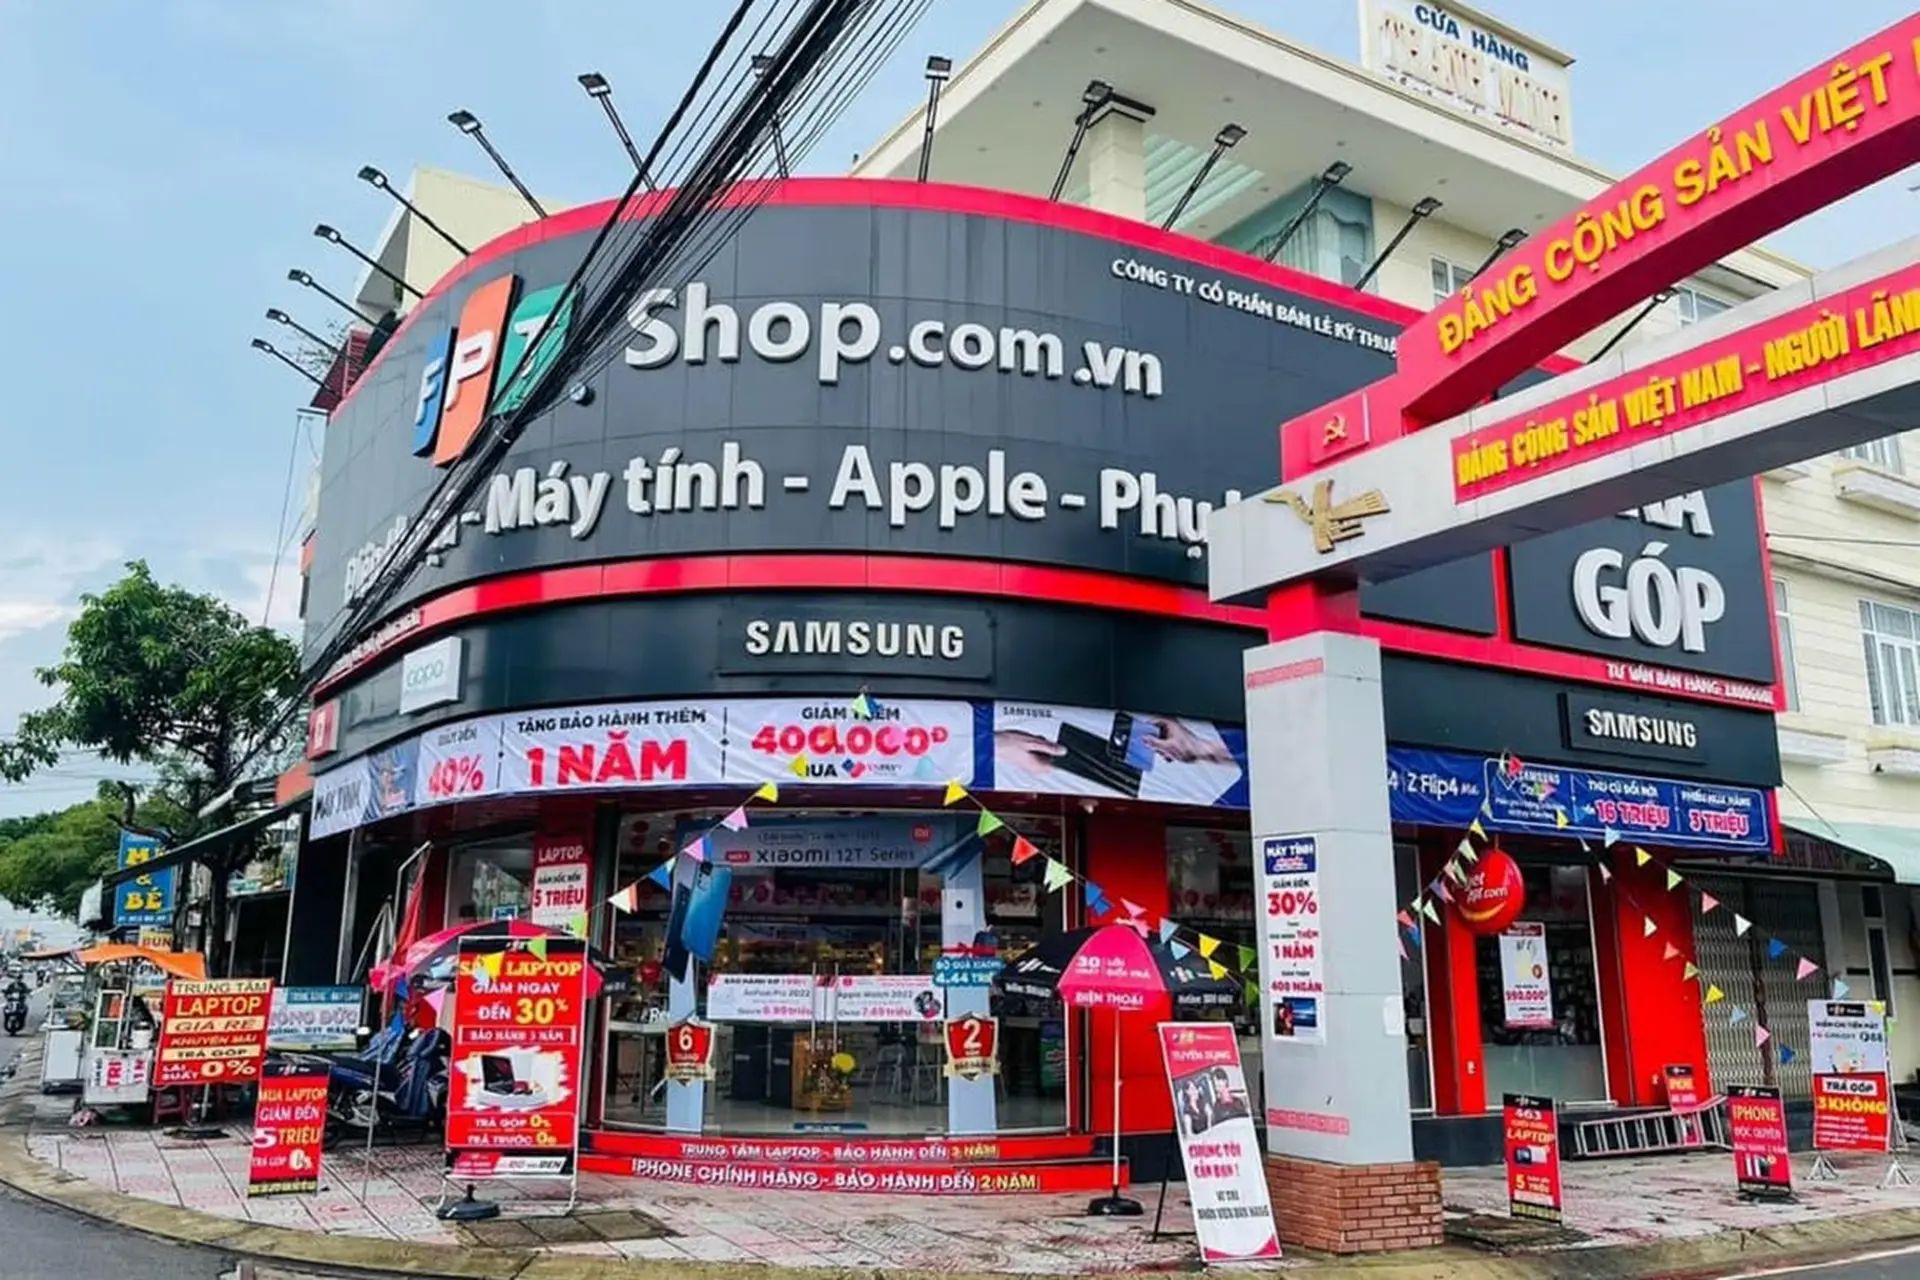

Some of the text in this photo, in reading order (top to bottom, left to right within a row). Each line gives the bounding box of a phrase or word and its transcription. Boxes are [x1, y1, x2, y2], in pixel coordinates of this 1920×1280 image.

[1415, 4, 1530, 73] CỬA HÀNG
[1438, 265, 1537, 354] ĐẢNG
[1544, 185, 1666, 272] CỘNG
[1674, 120, 1774, 206] SẢN
[1781, 52, 1893, 144] VIỆT
[1112, 258, 1168, 288] CÔNG
[1171, 274, 1195, 294] TY
[1276, 304, 1312, 328] BÁN
[1357, 329, 1397, 358] THUẬ
[1458, 429, 1507, 486] ĐẢNG
[1513, 417, 1569, 468] CỘNG
[1573, 396, 1617, 447] SẢN
[1624, 374, 1676, 427] VIỆT
[1682, 354, 1743, 409] NAM
[1764, 309, 1850, 381] NGƯỜI
[485, 461, 611, 539] Máy
[623, 441, 765, 515] tính
[784, 475, 809, 490] -
[828, 445, 1048, 529] Apple
[1060, 493, 1085, 508] -
[1101, 468, 1212, 558] Phụ
[1573, 541, 1725, 652] GÓP
[746, 620, 964, 658] SAMSUNG
[1607, 663, 1625, 679] TƯ
[1655, 670, 1683, 688] BÁN
[517, 707, 706, 736] TẶNG BẢO HÀNH THÊM
[802, 703, 847, 720] GIẢM
[1586, 708, 1697, 748] SAMSUNG
[526, 730, 688, 787] 1 NĂM
[1407, 773, 1459, 802] Z Flip4
[1595, 800, 1618, 823] 16
[1619, 801, 1670, 831] TRIỆU
[1689, 808, 1750, 839] 3 TRIỆU
[538, 845, 584, 863] LAPTOP
[837, 849, 861, 863] 12T
[871, 848, 915, 862] Series
[125, 886, 163, 911] BÉ
[534, 884, 585, 908] 5 TRIỆU
[1267, 891, 1318, 916] 30%
[1282, 941, 1315, 960] NĂM
[505, 961, 582, 976] LAPTOP
[175, 980, 268, 995] TRUNG TÂM
[517, 982, 561, 994] NGAY
[789, 988, 811, 998] 2022
[176, 997, 261, 1017] LAPTOP
[478, 997, 569, 1024] ĐẾN 30%
[680, 1025, 693, 1051] 6
[962, 1019, 982, 1049] 2
[201, 1060, 257, 1077] 0%
[285, 1086, 328, 1101] LAPTOP
[1826, 1080, 1874, 1093] TRẢ GÓP
[260, 1104, 291, 1121] GIẢM
[1732, 1104, 1779, 1122] IPHONE
[1817, 1096, 1888, 1115] 3 KHÔNG
[475, 1117, 497, 1128] TRẢ
[253, 1123, 320, 1148] 5 TRIỆU
[468, 1134, 489, 1145] TRẢ
[1506, 1127, 1556, 1145] LAPTOP
[681, 1143, 727, 1156] TRUNG
[731, 1141, 761, 1155] TÂM
[765, 1146, 821, 1158] LAPTOP
[834, 1144, 866, 1158] BẢO
[870, 1145, 914, 1158] HÀNH
[919, 1142, 948, 1158] ĐẾN
[963, 1143, 998, 1157] NĂM
[631, 1157, 693, 1178] IPHONE
[697, 1163, 757, 1184] CHÍNH
[834, 1168, 876, 1187] BẢO
[881, 1171, 935, 1188] HÀNH
[940, 1168, 975, 1188] ĐẾN
[979, 1175, 992, 1188] 2
[996, 1172, 1037, 1188] NĂM
[1515, 1174, 1526, 1190] 5
